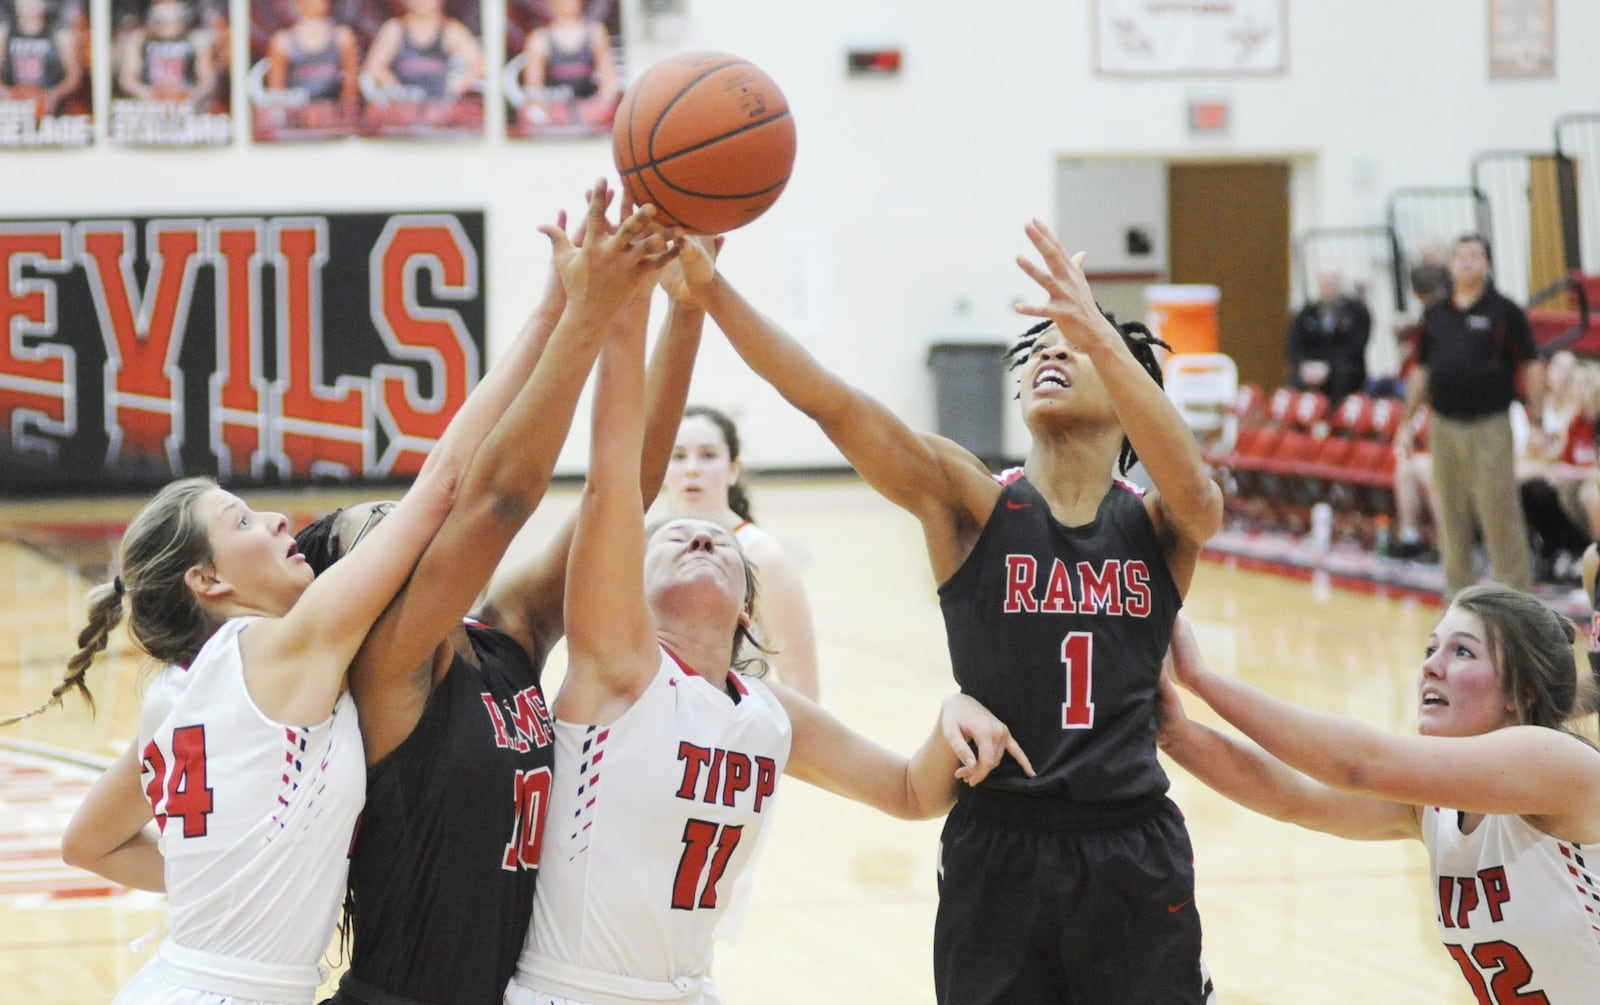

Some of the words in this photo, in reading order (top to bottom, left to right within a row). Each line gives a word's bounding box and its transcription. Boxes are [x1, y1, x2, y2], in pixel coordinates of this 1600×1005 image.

[1004, 554, 1151, 618] RAMS
[1061, 631, 1095, 729] 1
[141, 724, 214, 838] 24
[502, 766, 552, 871] 10
[675, 740, 776, 813] TIPP
[671, 818, 745, 911] 11
[1438, 865, 1511, 929] IPP
